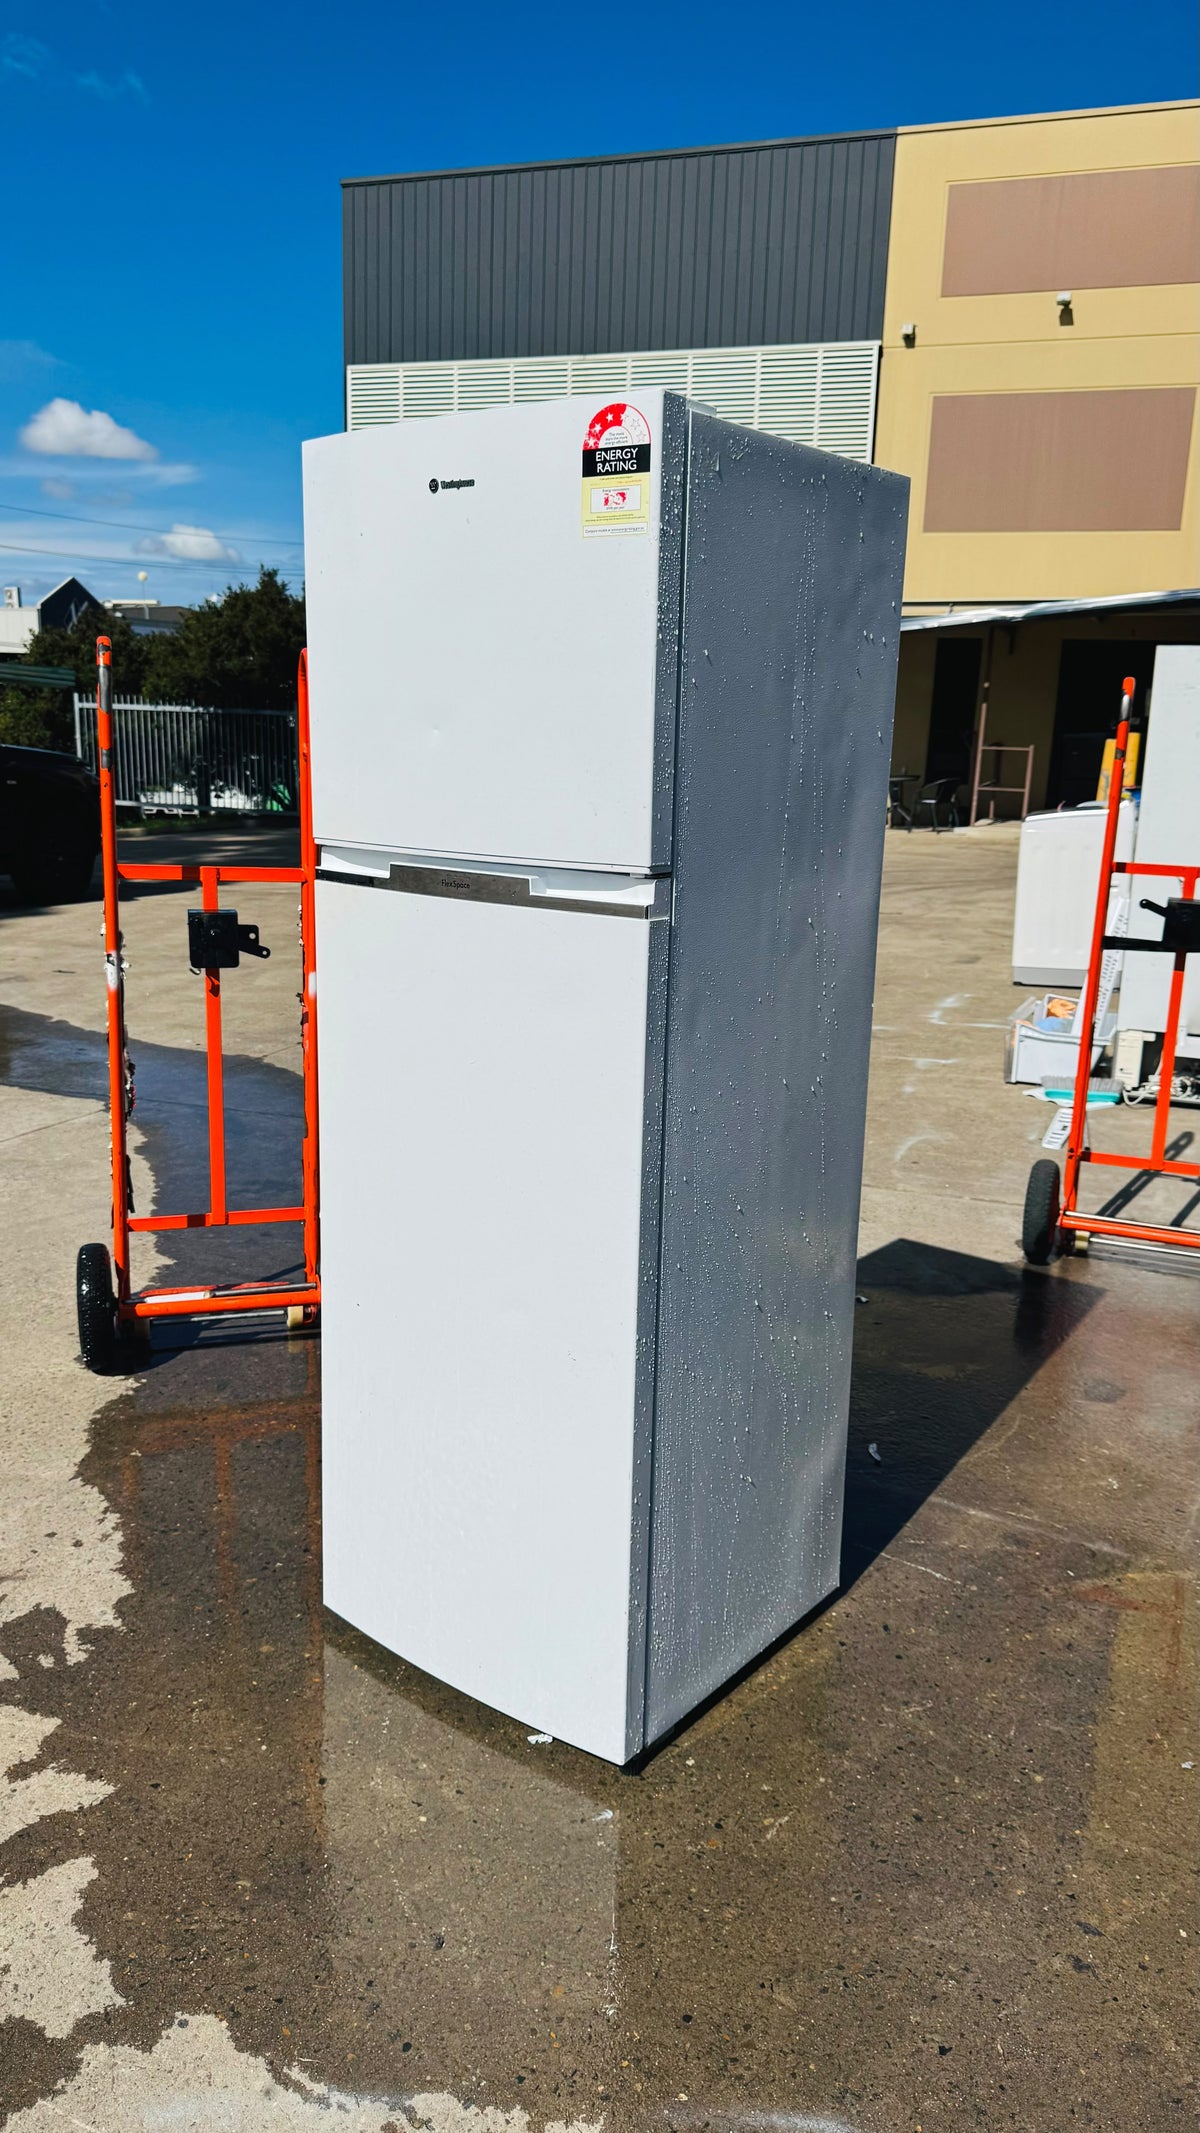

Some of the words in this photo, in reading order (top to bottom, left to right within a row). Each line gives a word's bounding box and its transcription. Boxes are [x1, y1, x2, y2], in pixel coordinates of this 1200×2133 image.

[595, 447, 638, 462] ENERGY
[597, 460, 637, 473] RATING
[441, 879, 470, 890] FlexSpace
